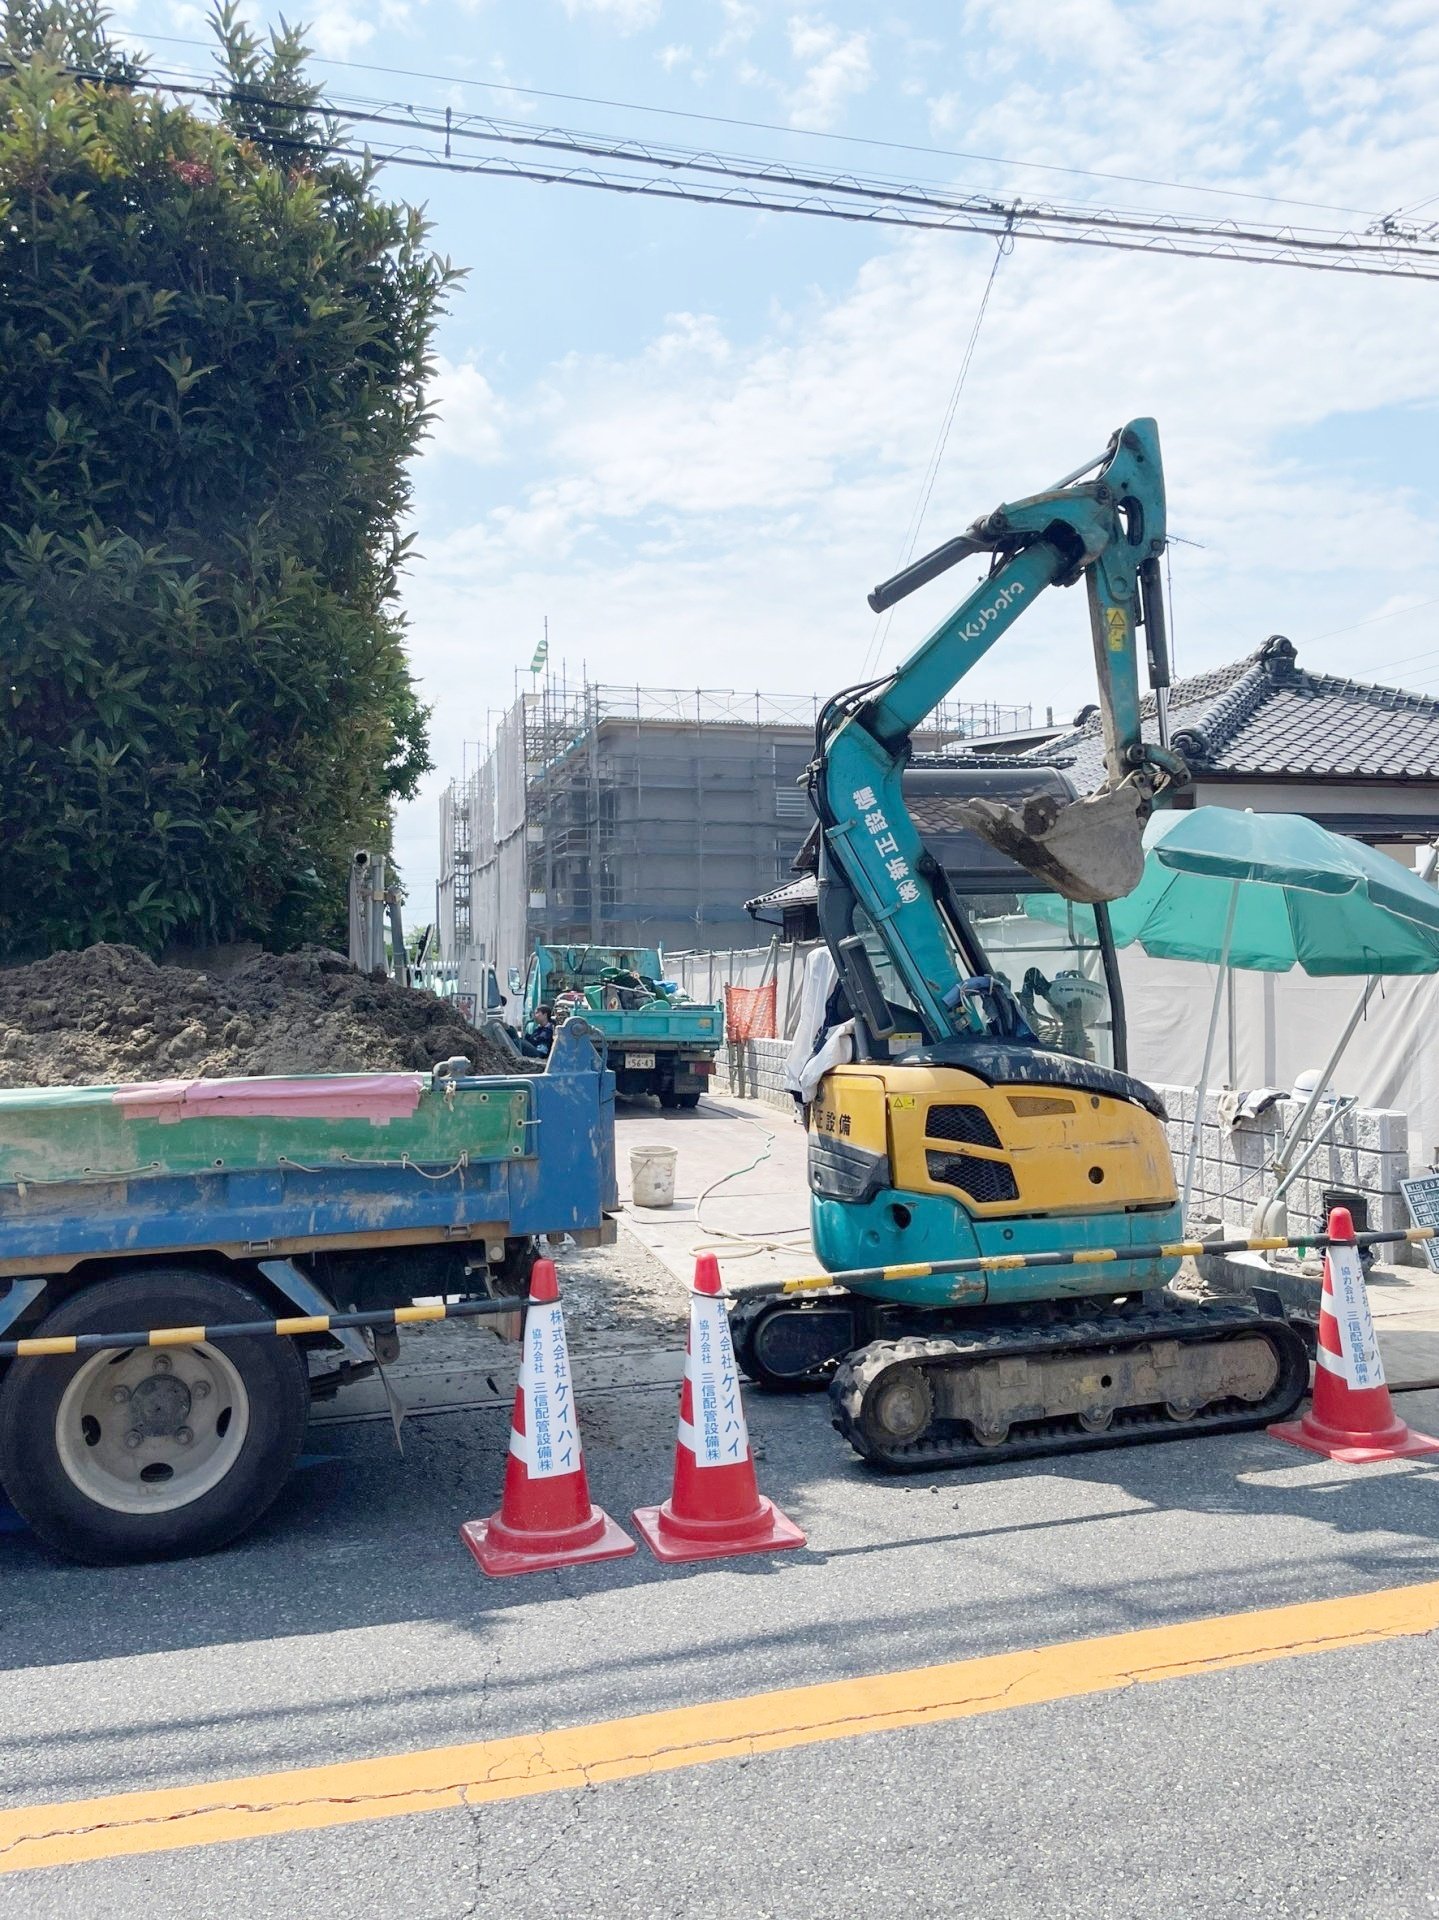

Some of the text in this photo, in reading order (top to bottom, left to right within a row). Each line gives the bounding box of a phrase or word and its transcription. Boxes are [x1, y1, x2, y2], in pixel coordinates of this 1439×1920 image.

[957, 580, 1025, 642] Kubota
[1340, 1266, 1356, 1305] 協力会社
[531, 1328, 545, 1374] 協力会社
[699, 1319, 712, 1365] 協力会社
